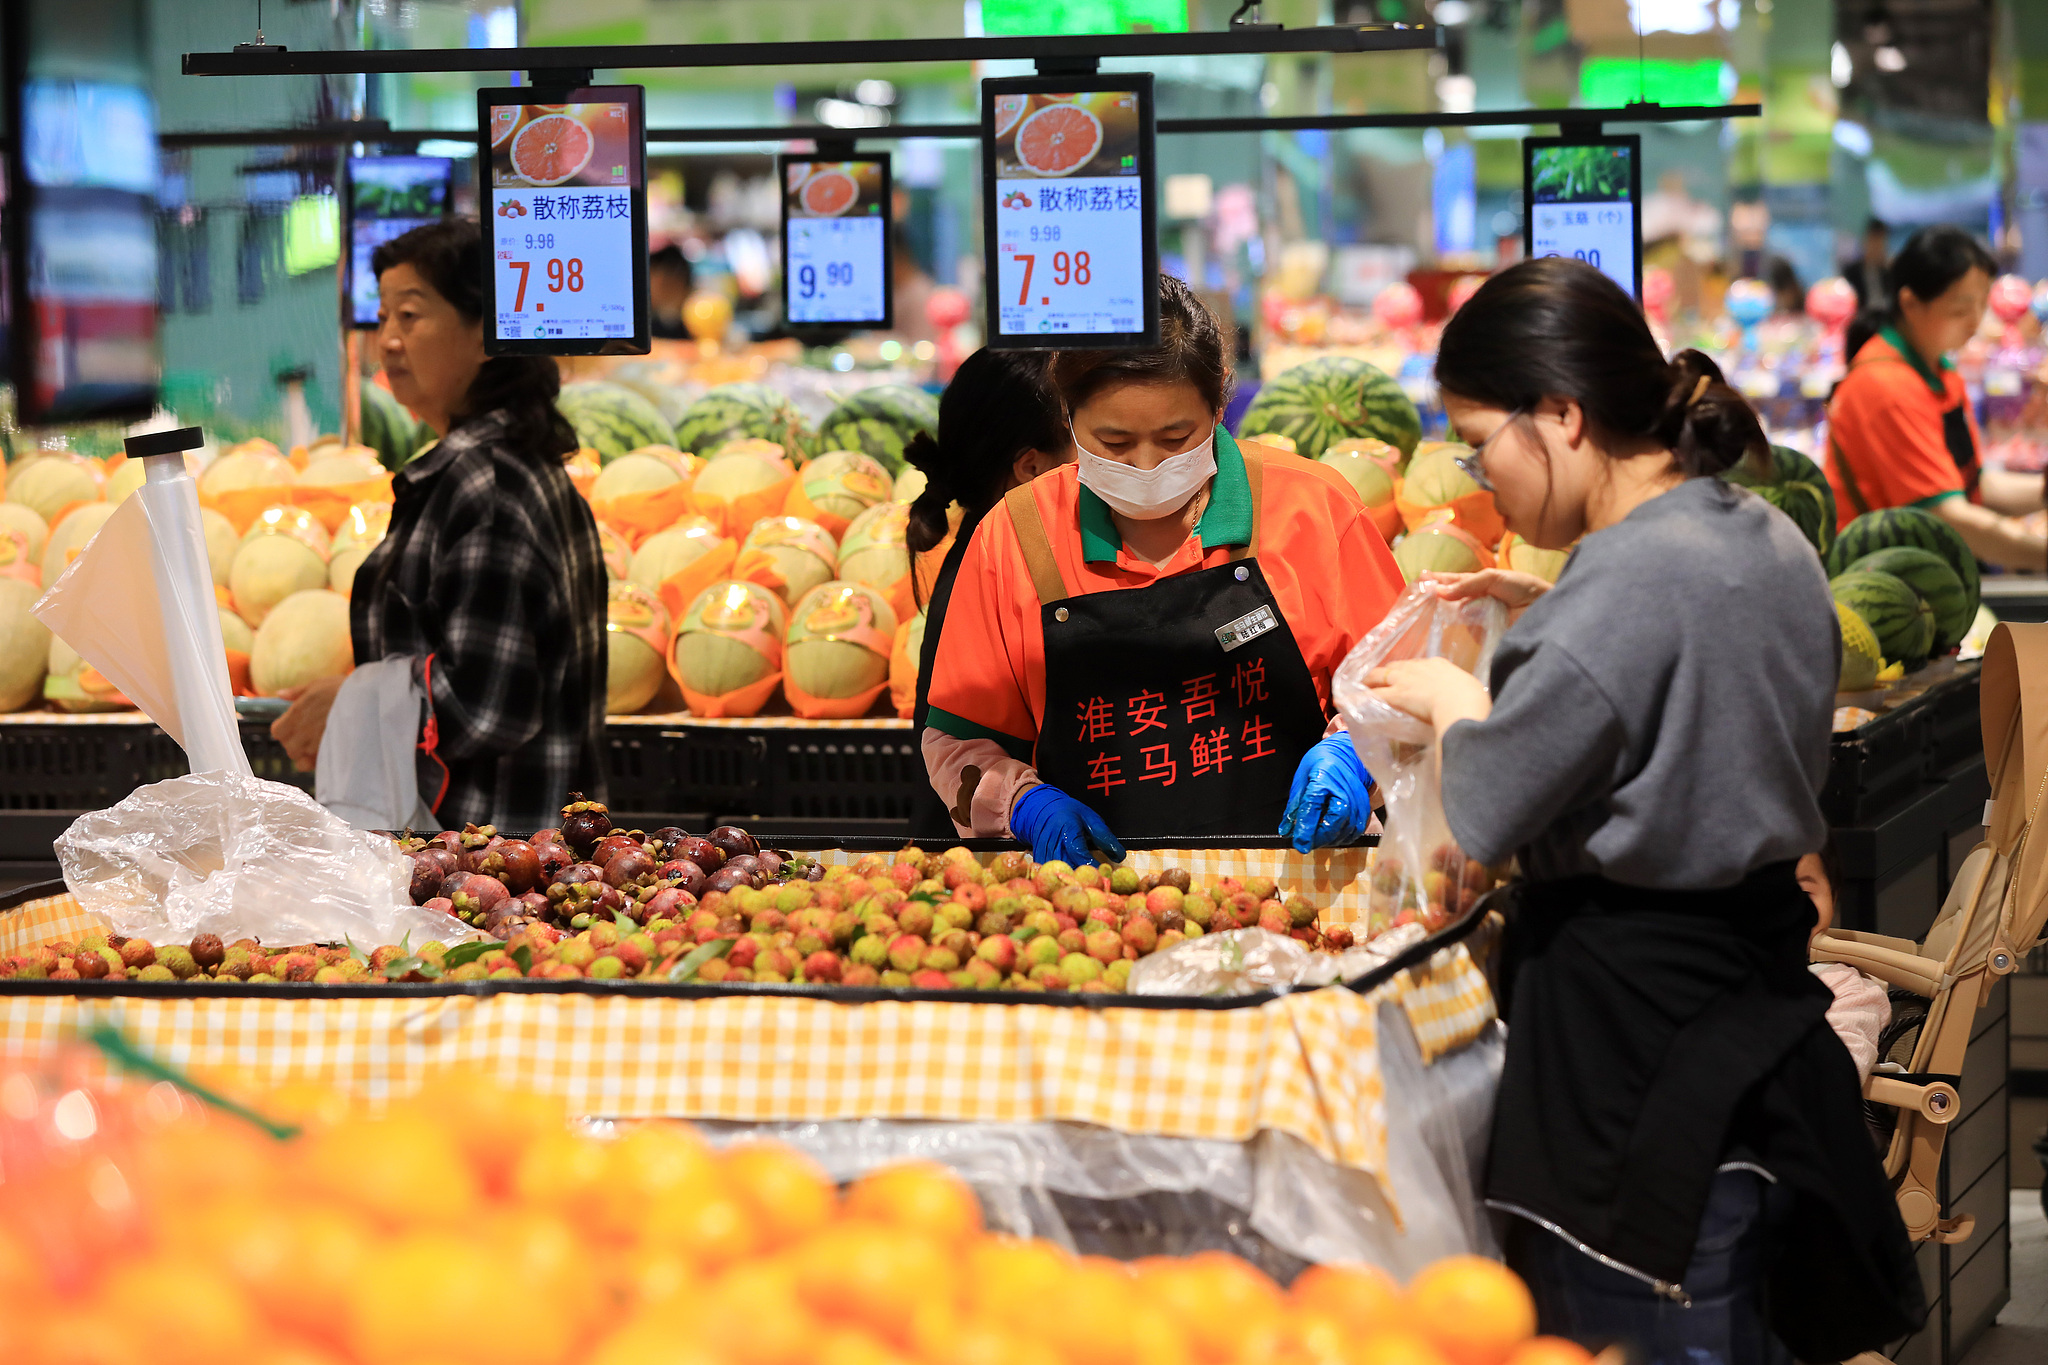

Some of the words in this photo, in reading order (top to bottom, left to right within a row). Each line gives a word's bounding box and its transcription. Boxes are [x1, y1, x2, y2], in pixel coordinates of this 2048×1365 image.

[533, 194, 630, 220] 散称荔枝
[1038, 185, 1139, 212] 散称荔枝
[525, 233, 555, 249] 9.98
[1030, 225, 1061, 242] 9.98
[509, 258, 584, 312] 7.98
[1013, 251, 1091, 305] 7.98
[1076, 657, 1270, 743] 淮安吾悦
[1087, 714, 1277, 797] 车马鲜生
